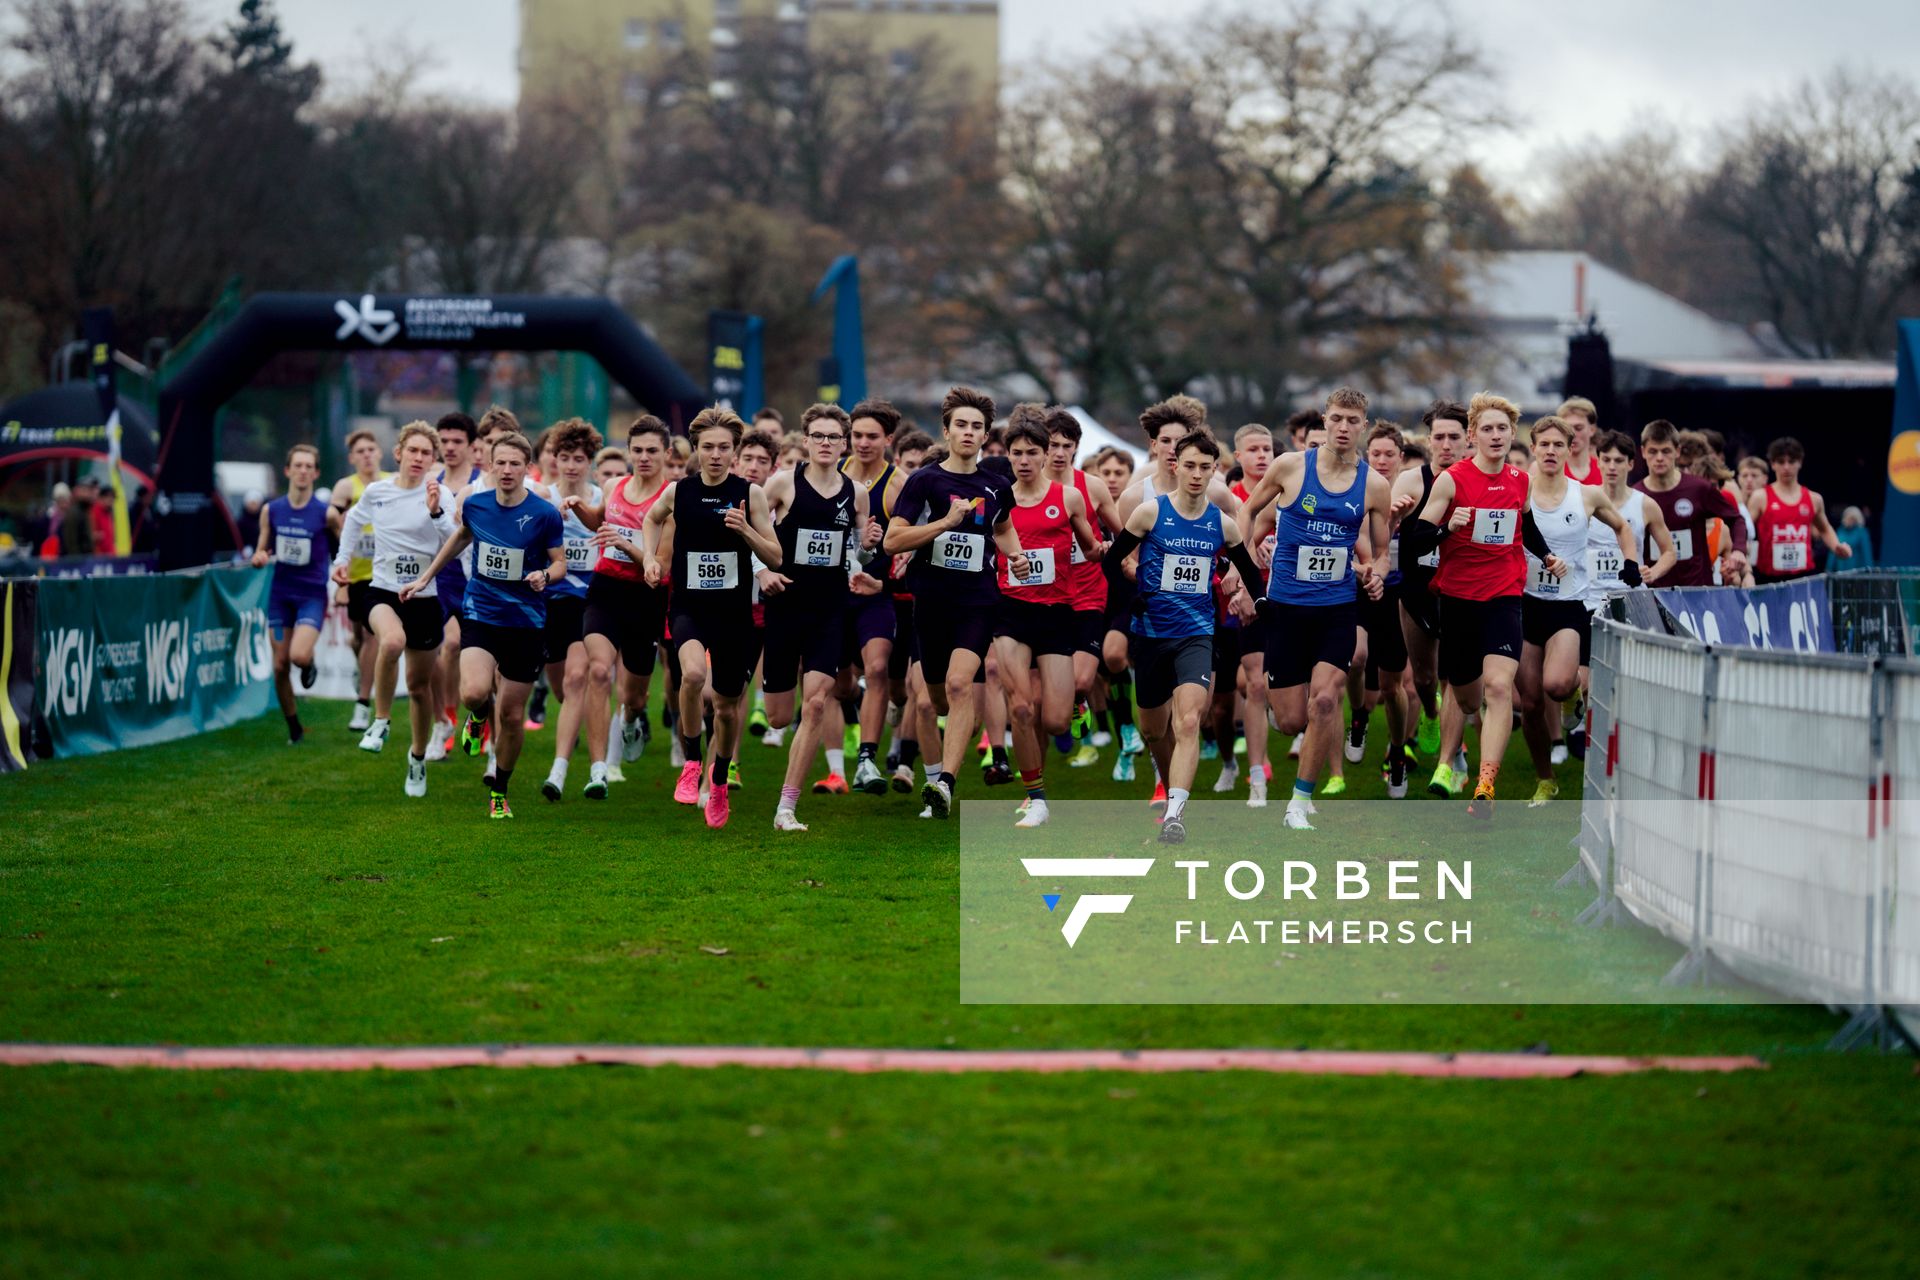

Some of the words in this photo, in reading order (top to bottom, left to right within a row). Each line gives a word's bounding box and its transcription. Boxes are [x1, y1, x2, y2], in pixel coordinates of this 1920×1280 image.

[617, 528, 633, 537] GLS
[1307, 520, 1347, 535] HEITEC
[1493, 520, 1500, 534] 1
[812, 532, 830, 540] GLS
[950, 534, 968, 543] GLS
[568, 539, 585, 547] GLS
[807, 541, 832, 556] 641
[1164, 537, 1214, 551] watttron
[489, 546, 507, 556] GLS
[565, 548, 589, 560] 907
[944, 544, 972, 560] 870
[1313, 548, 1332, 556] GLS
[1598, 550, 1614, 558] GLS
[486, 555, 510, 571] 581
[701, 554, 719, 563] GLS
[1178, 557, 1197, 566] GLS
[1308, 557, 1336, 571] 217
[395, 563, 420, 575] 540
[1029, 560, 1044, 574] 40
[1597, 559, 1619, 571] 112
[698, 564, 726, 579] 586
[1173, 567, 1200, 582] 948
